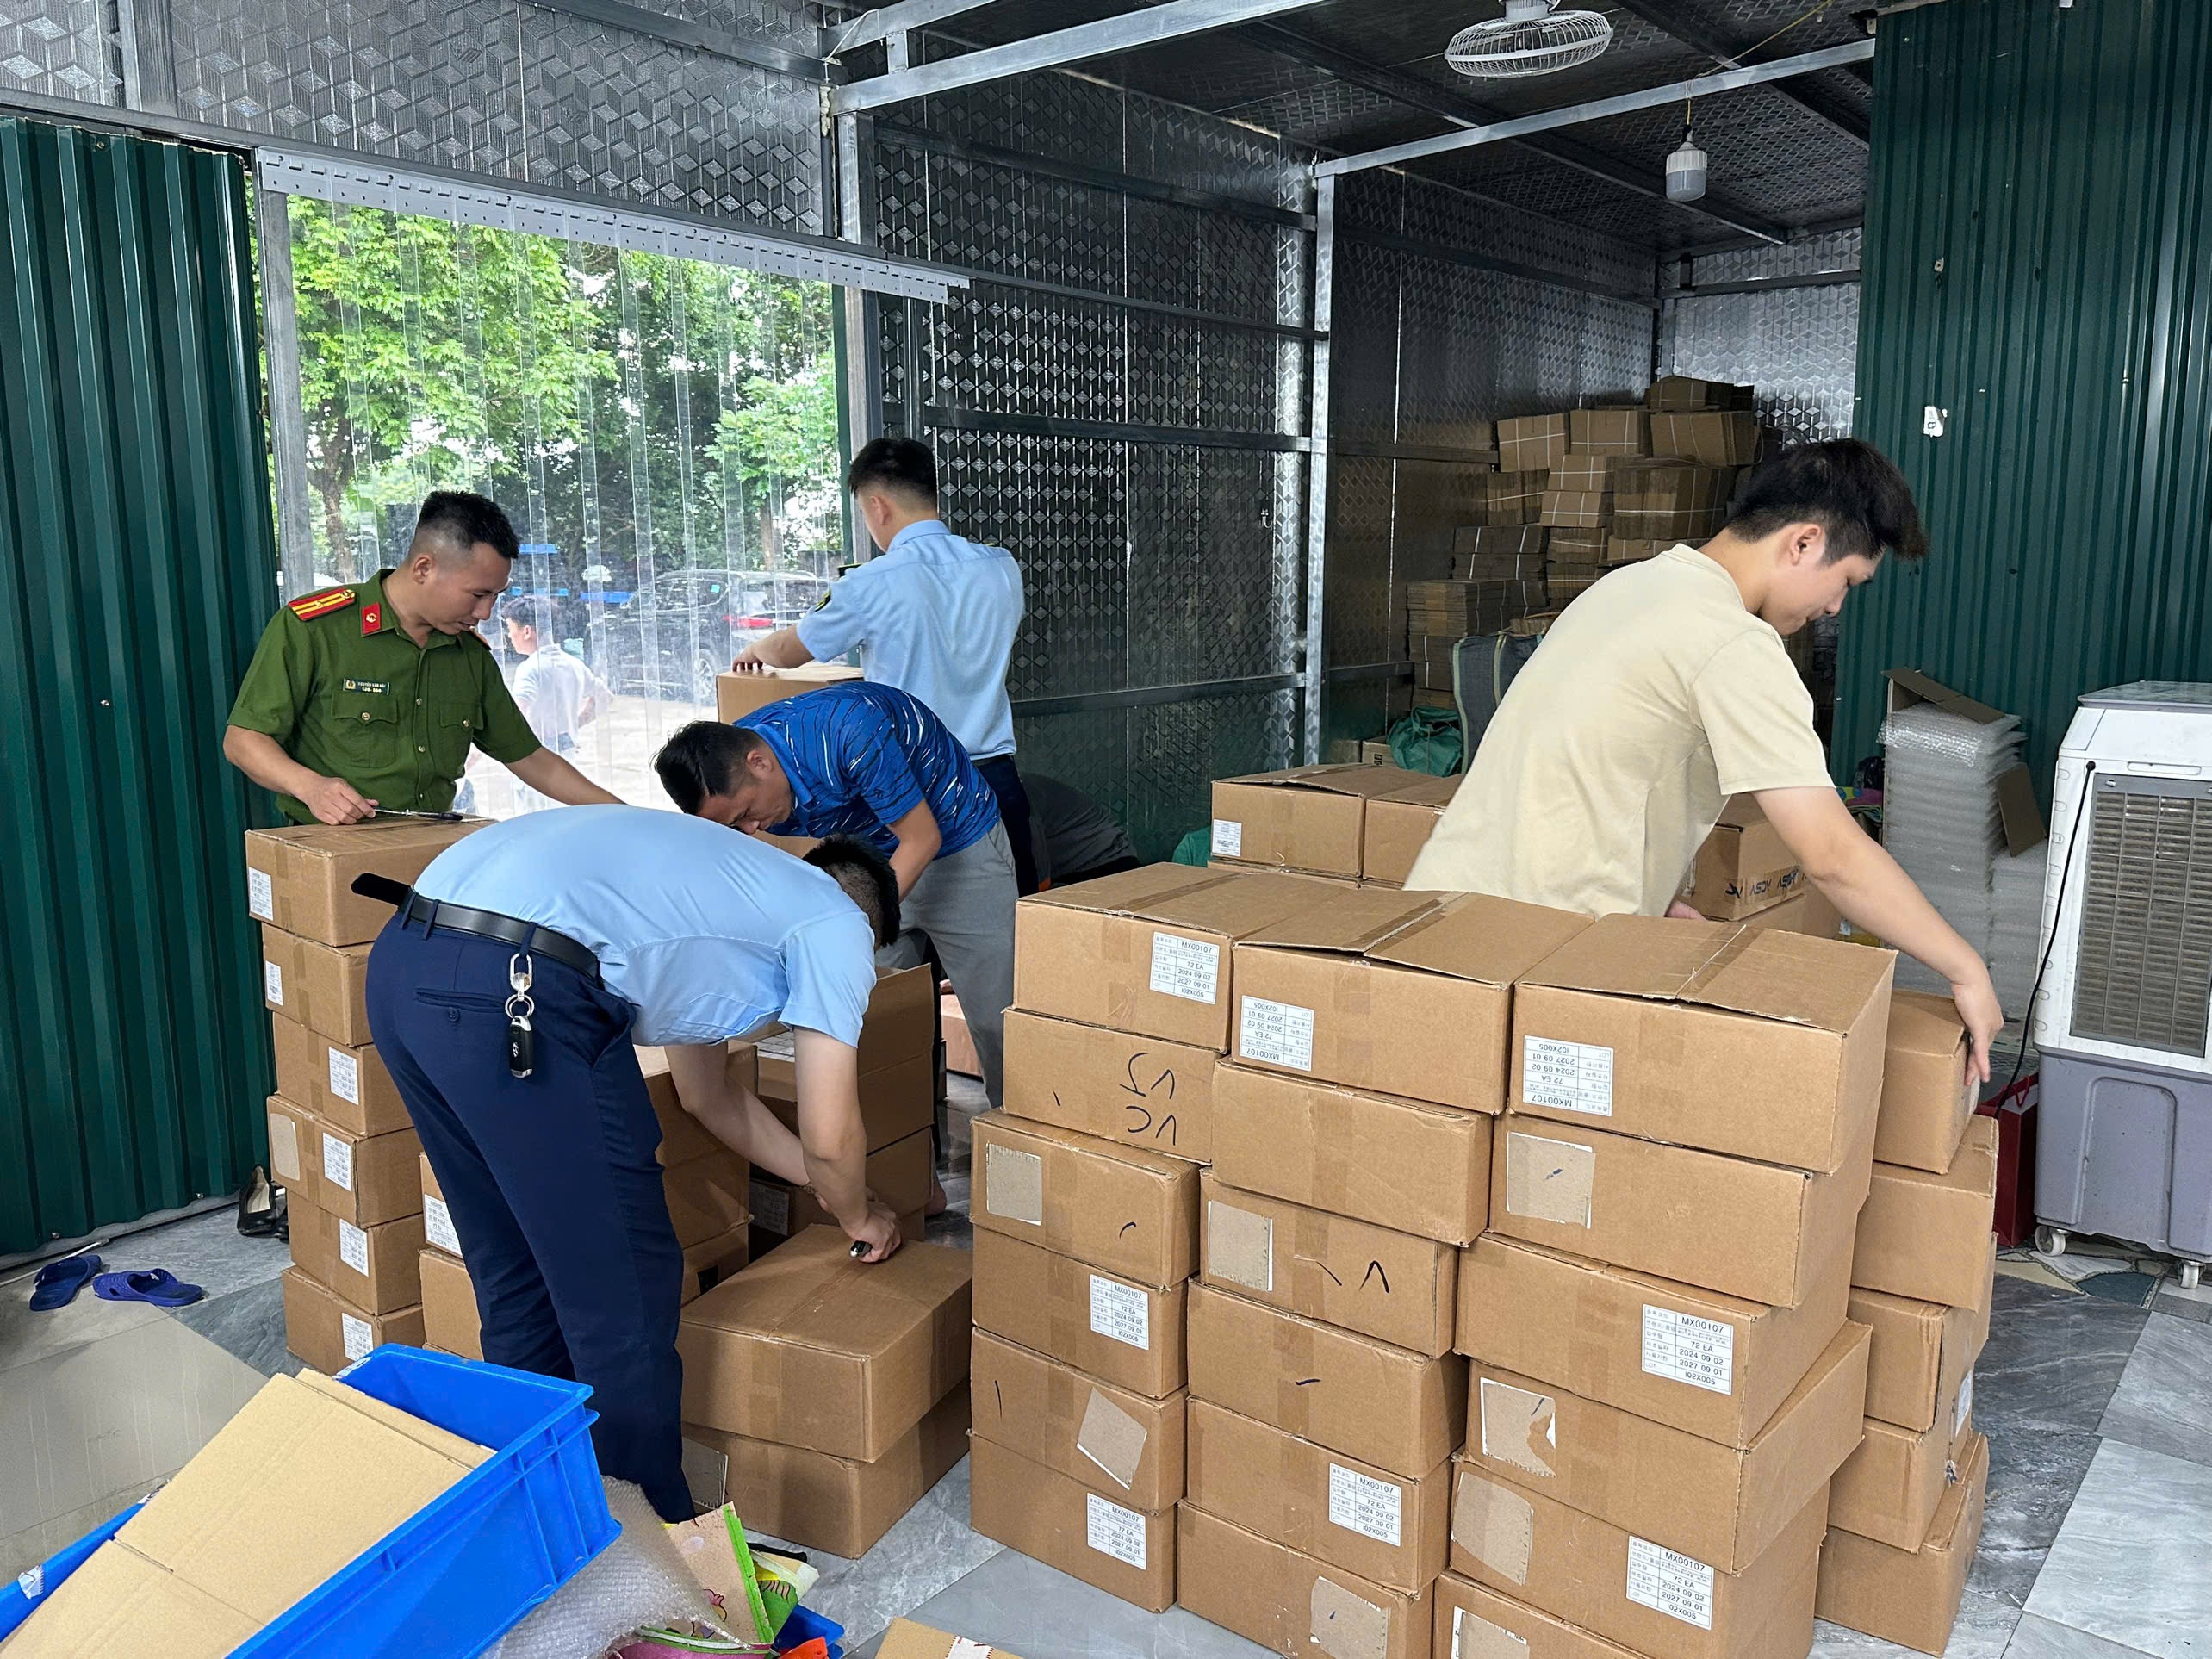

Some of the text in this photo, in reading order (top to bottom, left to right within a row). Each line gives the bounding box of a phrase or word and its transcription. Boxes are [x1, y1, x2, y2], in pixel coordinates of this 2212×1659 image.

[1181, 941, 1212, 954] MX00107
[1266, 1023, 1282, 1032] 2024
[1246, 1047, 1279, 1060] MX00107
[1556, 1056, 1575, 1065] 2027
[1555, 1066, 1574, 1075] 2024
[1531, 1093, 1571, 1107] MX00107
[1681, 1316, 1724, 1333] MX00107
[1690, 1340, 1713, 1352] 72 EA
[1679, 1348, 1698, 1358] 2024
[1713, 1357, 1723, 1365] 02
[1679, 1358, 1697, 1370] 2027
[1700, 1364, 1710, 1373] 09
[1360, 1477, 1393, 1494] MX00107
[1358, 1504, 1374, 1514] 2024
[1358, 1513, 1373, 1524] 2027
[1665, 1552, 1705, 1573] MX00107
[1673, 1575, 1694, 1588] 72 EA
[1662, 1581, 1703, 1601] 2024 09 02
[1662, 1591, 1679, 1602] 2027
